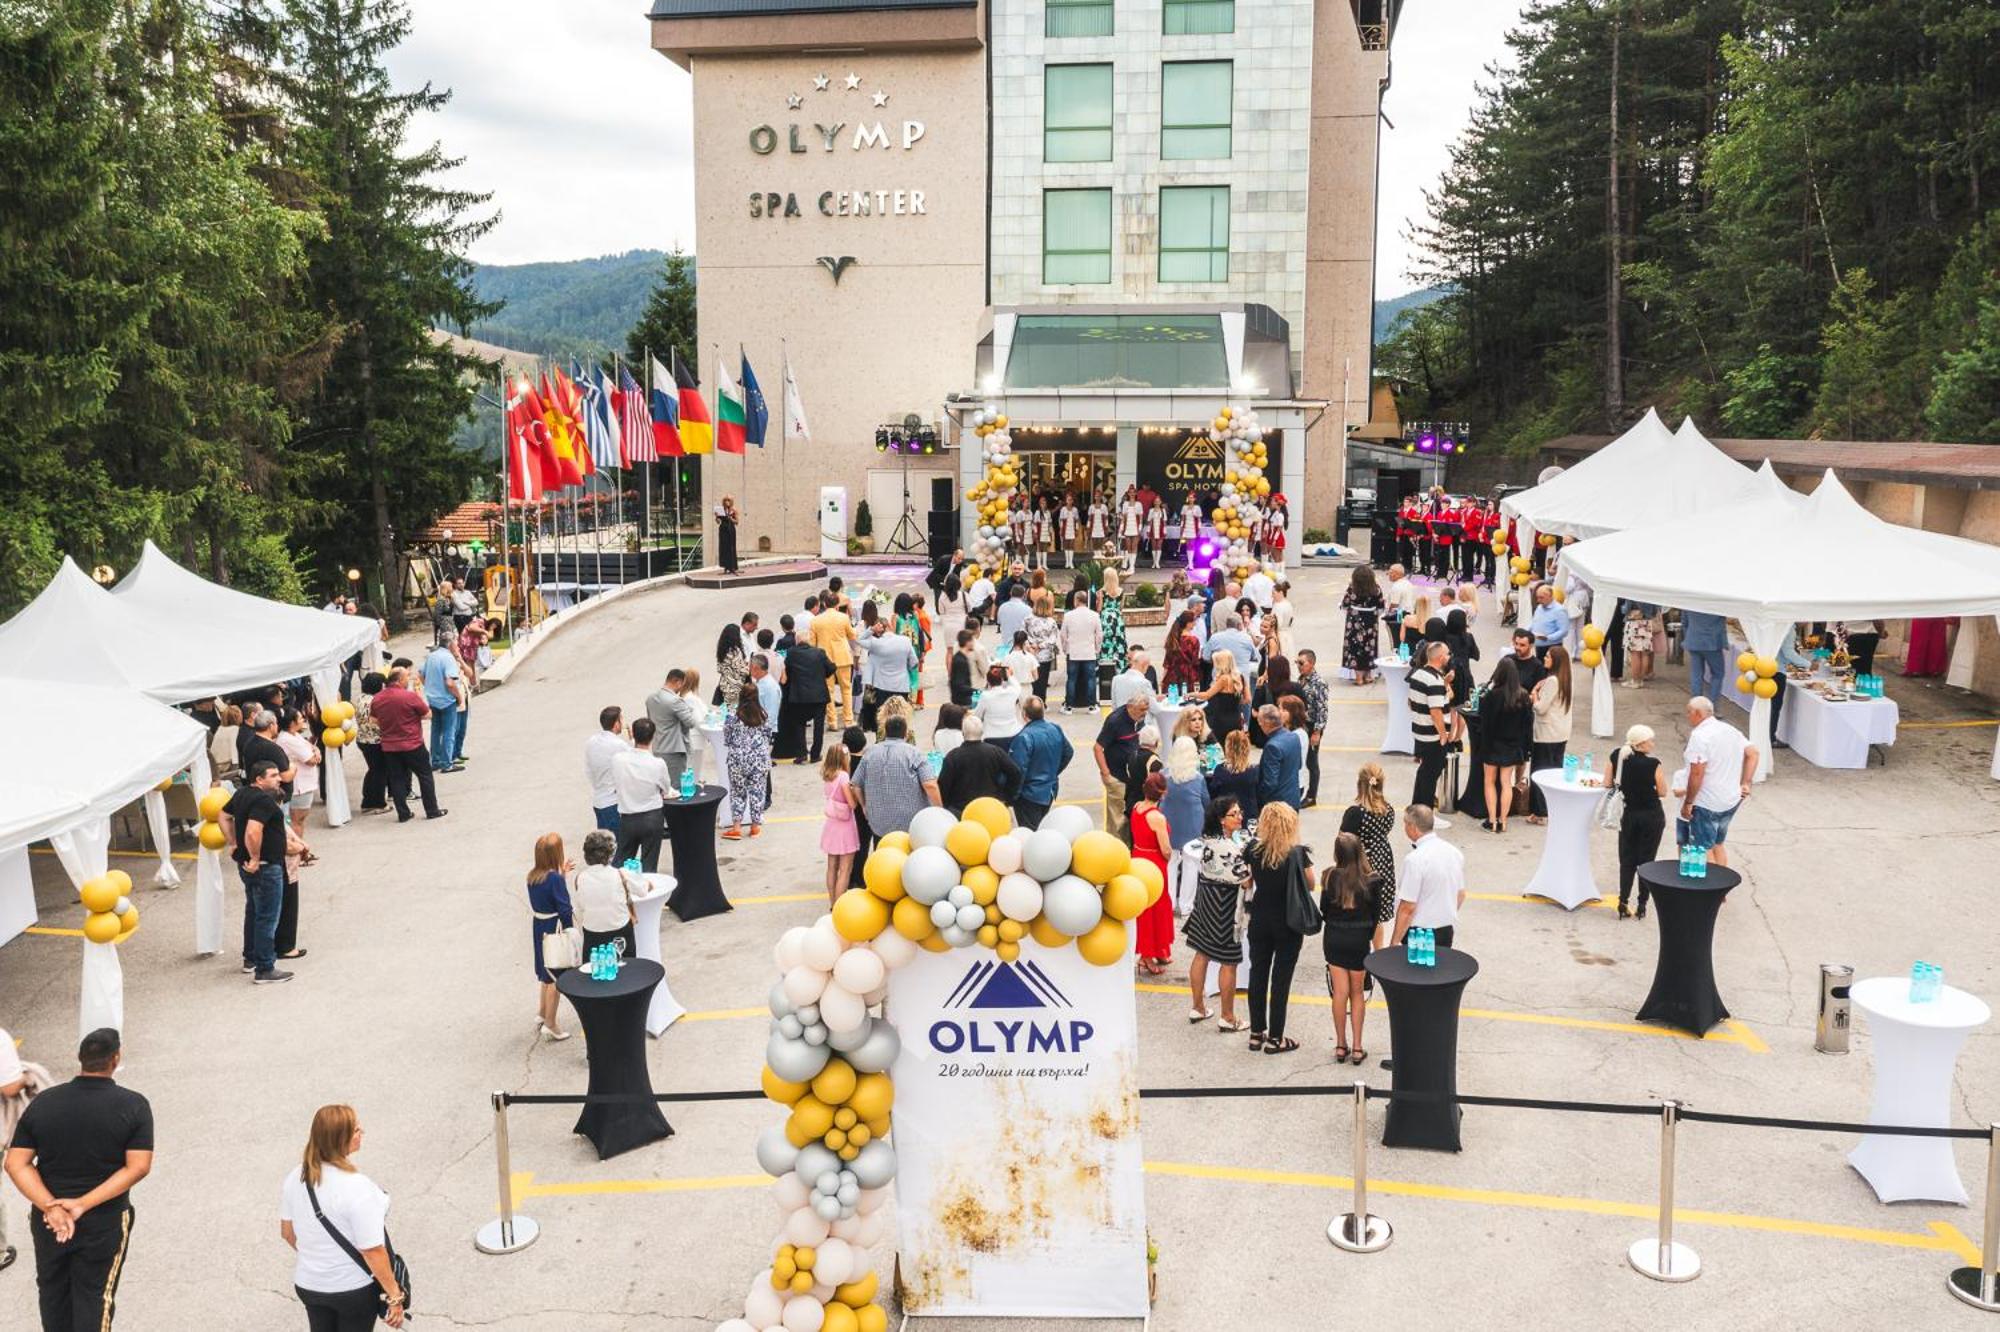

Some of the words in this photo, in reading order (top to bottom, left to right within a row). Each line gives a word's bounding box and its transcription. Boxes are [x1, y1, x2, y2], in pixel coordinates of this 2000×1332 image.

[749, 120, 926, 155] OLYMP
[749, 192, 802, 218] SPA
[818, 190, 928, 217] CENTER
[1165, 463, 1224, 479] OLYM
[1168, 482, 1189, 490] SPA
[928, 1020, 1094, 1054] OLYMP
[938, 1063, 960, 1077] 20
[961, 1062, 1013, 1077] години
